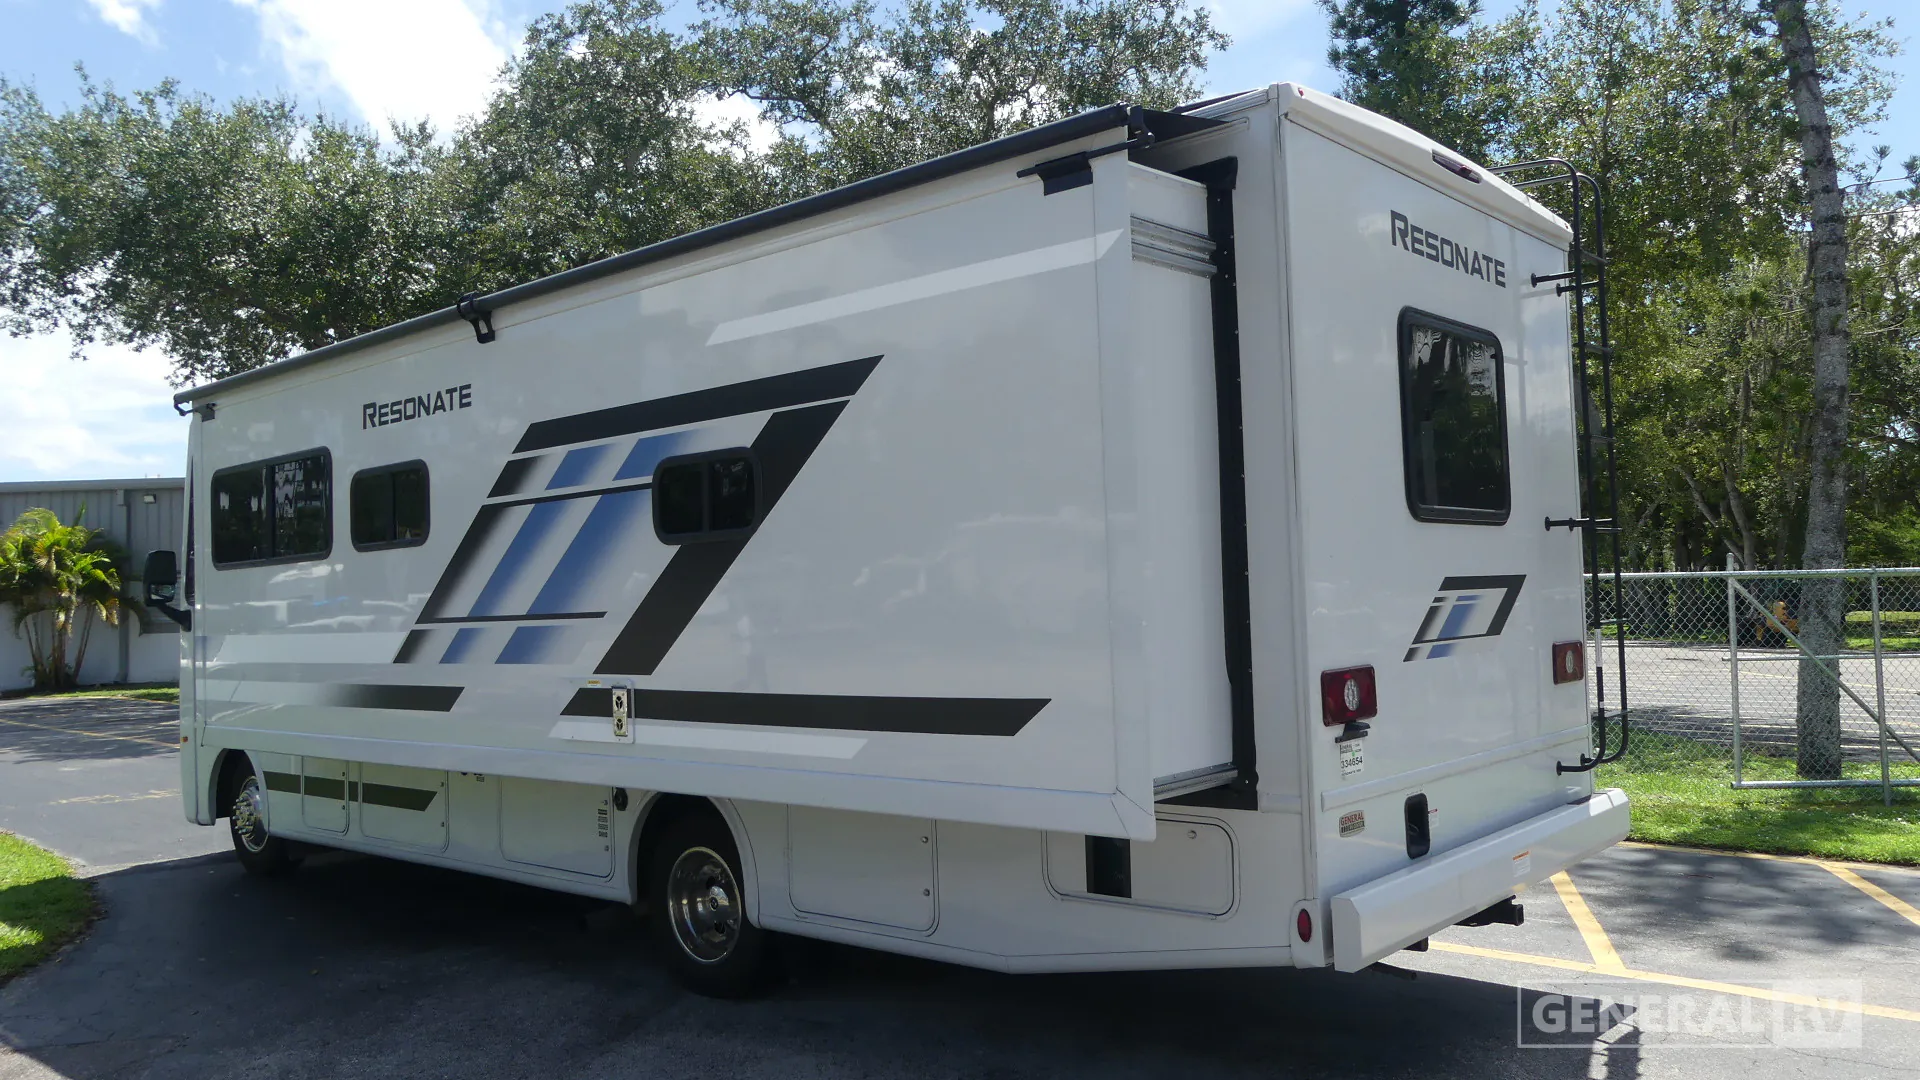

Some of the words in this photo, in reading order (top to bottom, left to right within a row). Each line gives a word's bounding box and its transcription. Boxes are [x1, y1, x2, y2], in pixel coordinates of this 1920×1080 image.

[1390, 209, 1506, 288] RESONATE
[362, 383, 472, 430] RESONATE
[1341, 756, 1363, 769] 334654
[1340, 811, 1364, 826] GENERAL
